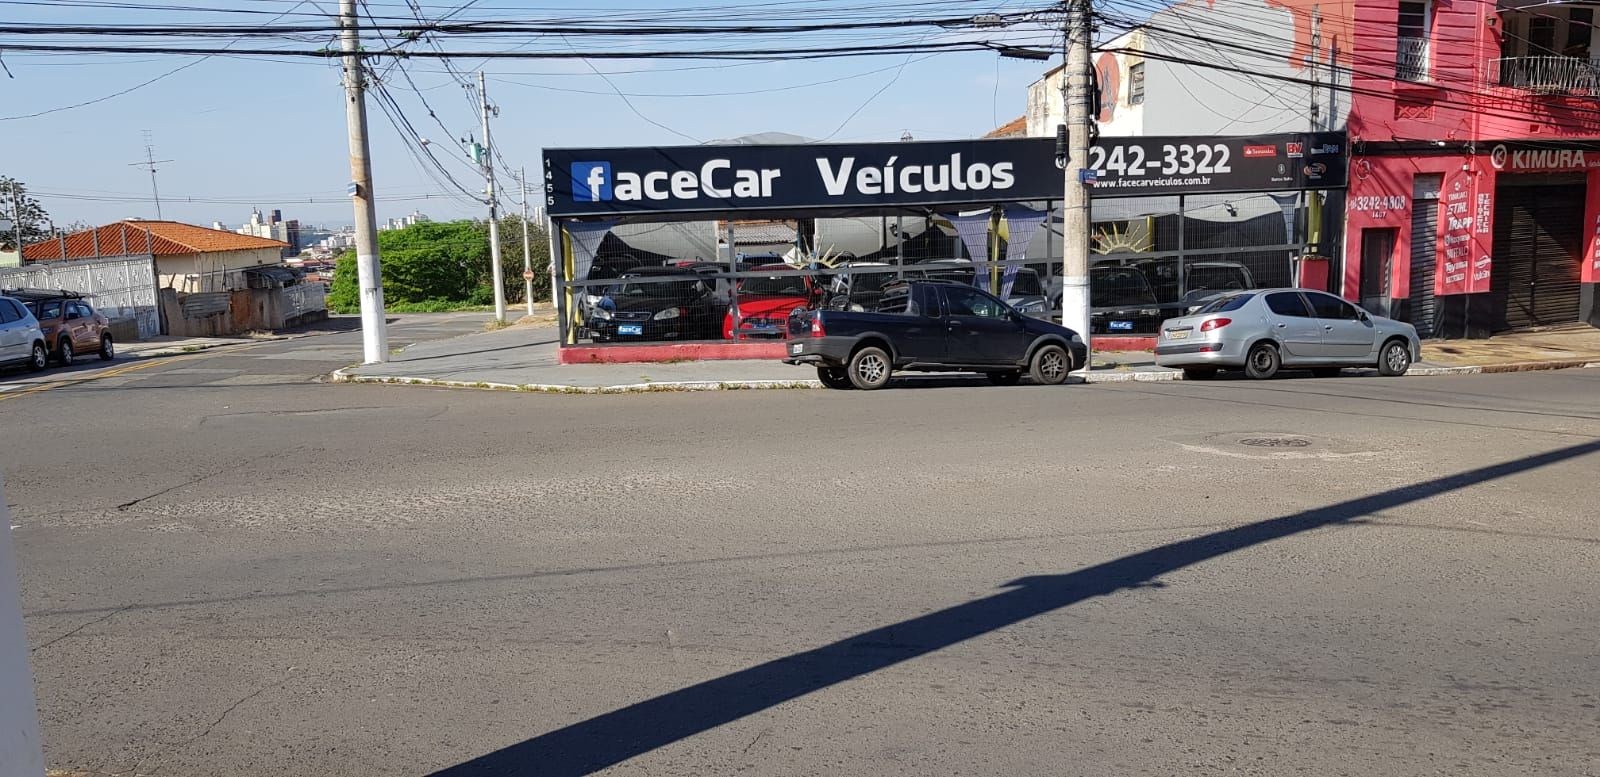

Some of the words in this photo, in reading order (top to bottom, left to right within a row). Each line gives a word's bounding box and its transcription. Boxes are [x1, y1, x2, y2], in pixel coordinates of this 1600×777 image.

[1512, 149, 1586, 169] KIMURA
[545, 158, 555, 206] 1455
[587, 159, 782, 203] faceCar
[815, 152, 1015, 196] Veículos
[1093, 176, 1211, 188] www.facecarveiculos.com.br
[1448, 216, 1473, 231] TRAPP
